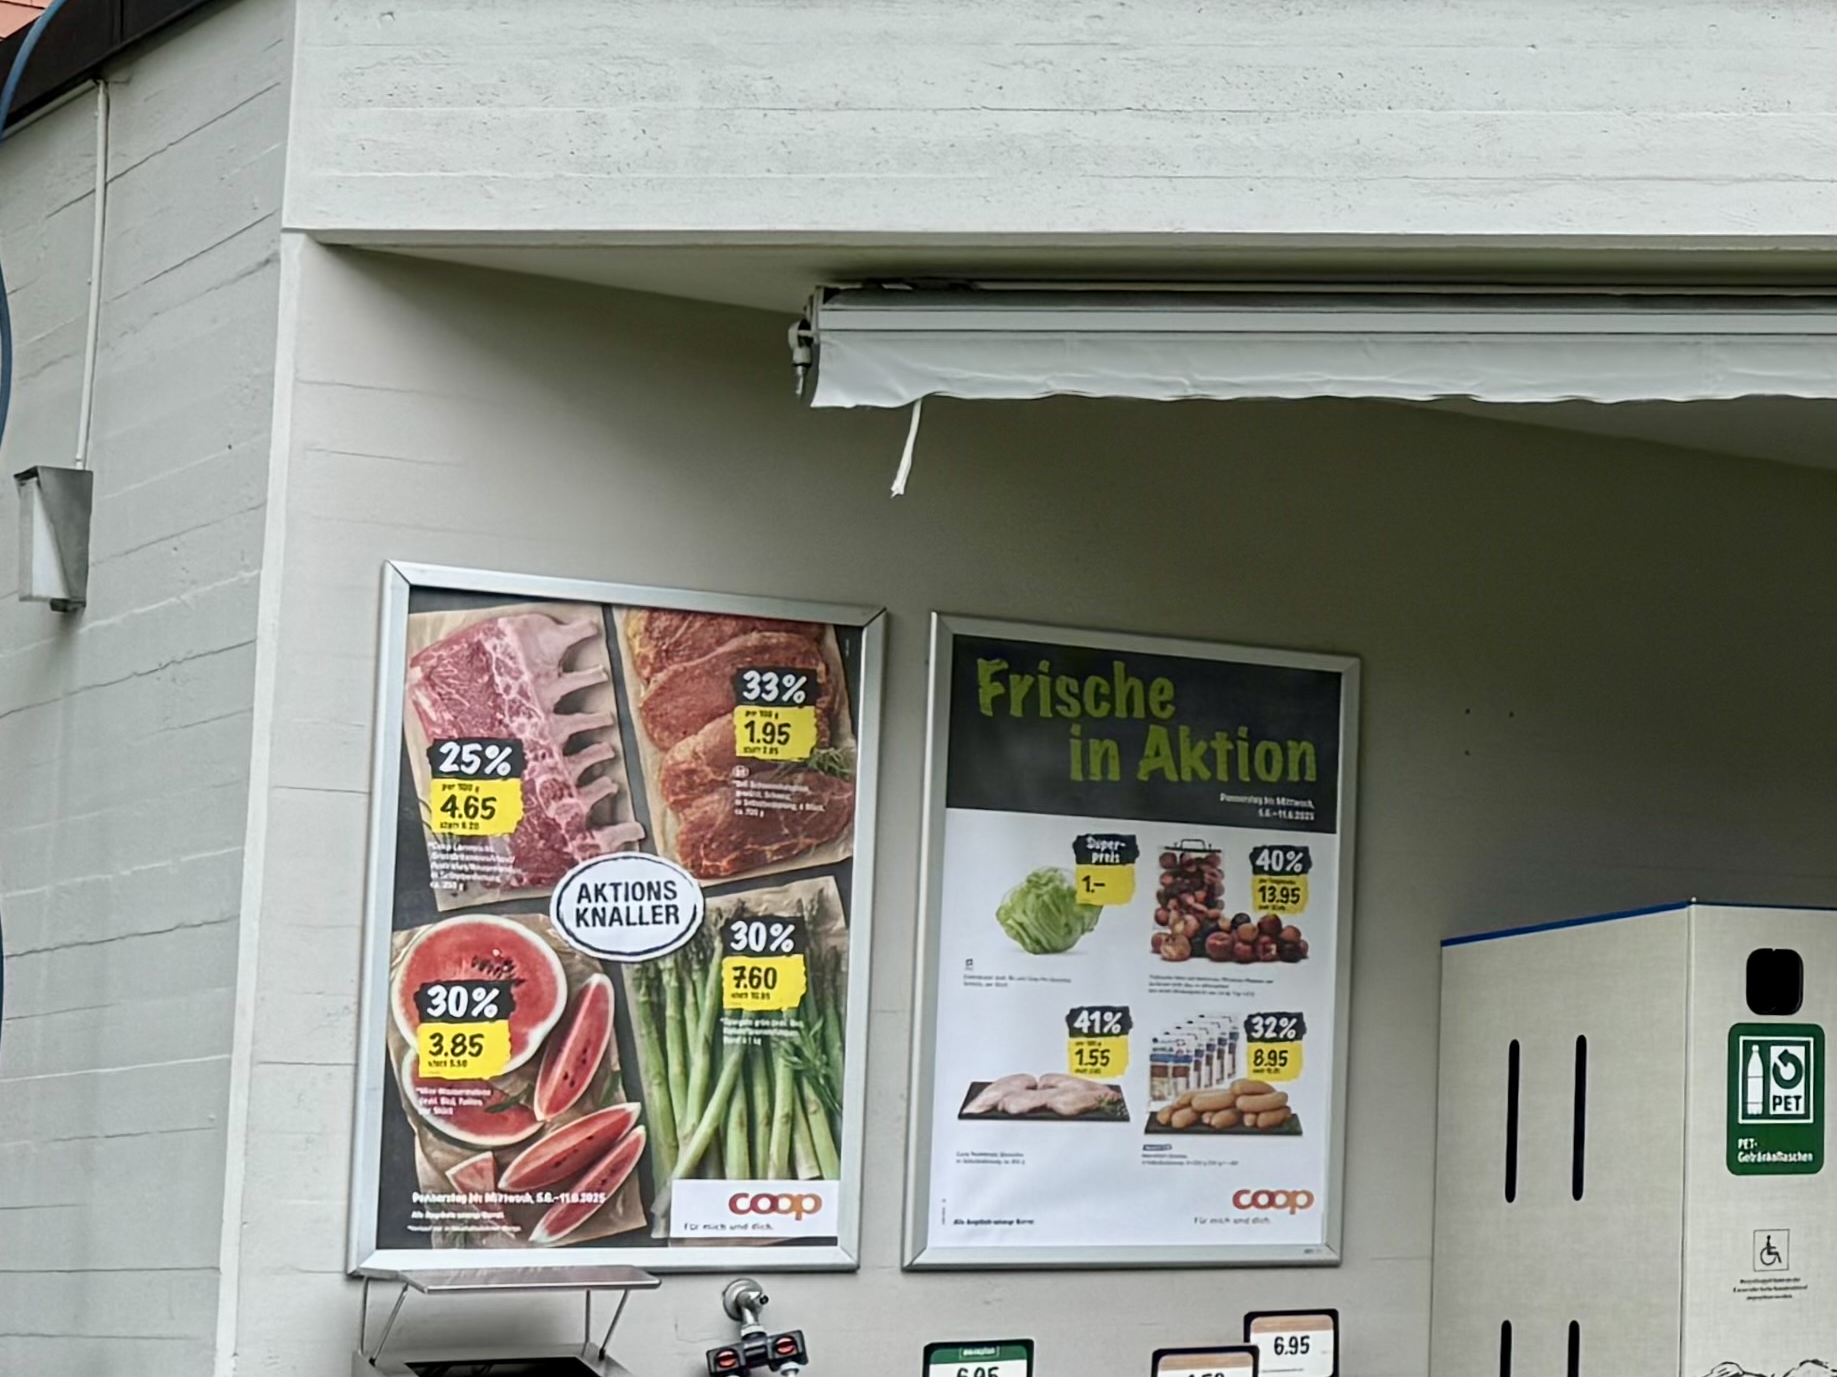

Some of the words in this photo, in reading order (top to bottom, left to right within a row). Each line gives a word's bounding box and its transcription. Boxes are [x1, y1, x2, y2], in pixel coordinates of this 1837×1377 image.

[742, 670, 808, 704] 33%
[977, 657, 1176, 720] Frische
[744, 720, 792, 746] 1.95
[438, 741, 513, 776] 25%
[1069, 723, 1121, 782] in
[1136, 723, 1317, 782] Aktion
[440, 794, 498, 820] 4.65
[1086, 835, 1126, 851] Super-
[1091, 851, 1121, 865] preis
[1255, 848, 1304, 873] 40%
[576, 880, 678, 905] AKTIONS
[1257, 885, 1300, 905] 13.95
[575, 904, 680, 928] KNALLER
[730, 920, 795, 953] 30%
[731, 965, 778, 990] 7.60
[426, 984, 500, 1018] 30%
[1073, 1009, 1122, 1035] 41%
[1250, 1016, 1298, 1040] 32%
[428, 1032, 485, 1058] 3.85
[1074, 1048, 1111, 1068] 1.55
[1252, 1049, 1289, 1068] 8.95
[1772, 1095, 1803, 1112] PET
[728, 1192, 822, 1221] coop
[1232, 1189, 1315, 1215] coop
[1273, 1335, 1310, 1356] 6.95
